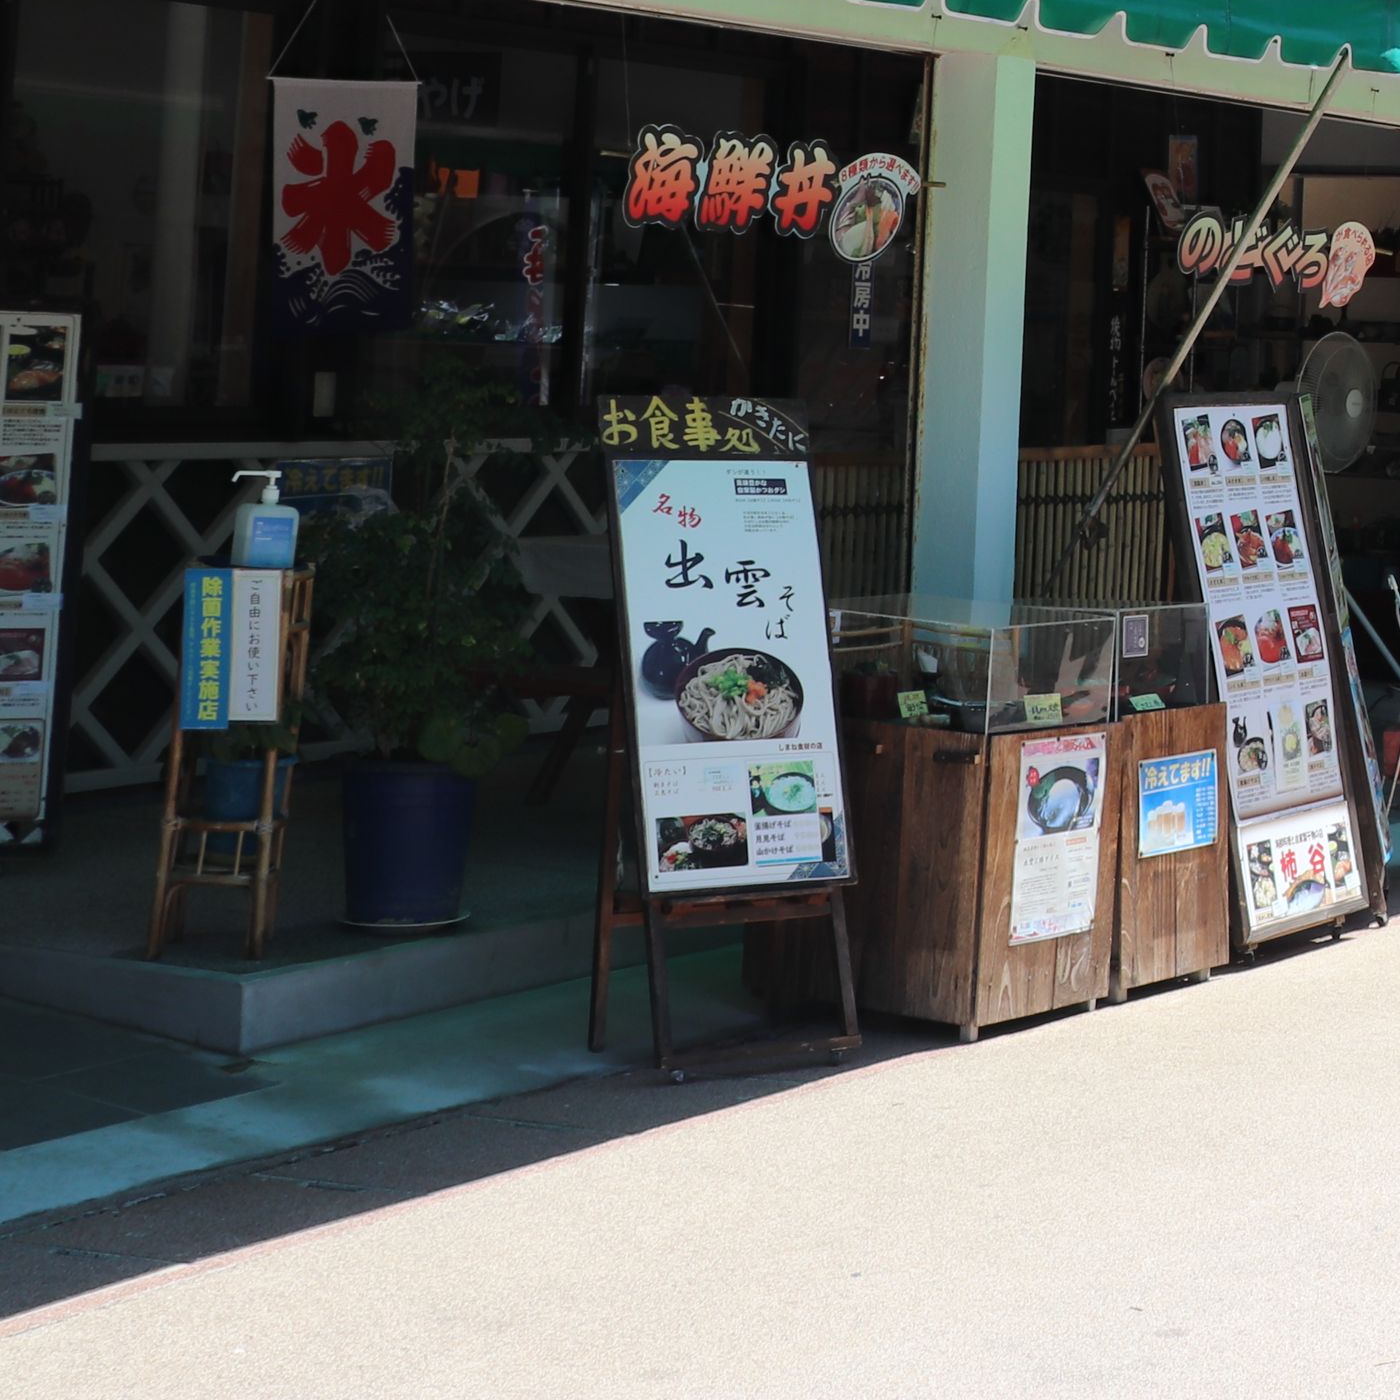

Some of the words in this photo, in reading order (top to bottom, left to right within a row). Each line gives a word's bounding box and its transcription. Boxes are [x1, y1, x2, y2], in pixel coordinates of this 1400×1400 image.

[281, 120, 396, 276] 氷
[628, 133, 838, 231] 海鮮丼
[1180, 216, 1328, 289] のどぐろ
[852, 260, 873, 338] 冷房中
[602, 396, 761, 453] お食事処
[730, 398, 808, 453] かきたに
[652, 493, 702, 528] 名物
[197, 576, 223, 722] 除菌作業実施店
[245, 580, 263, 712] ご自由にお使い下さい
[1145, 757, 1211, 789] 冷えてます!!
[1280, 843, 1325, 882] 柿谷
